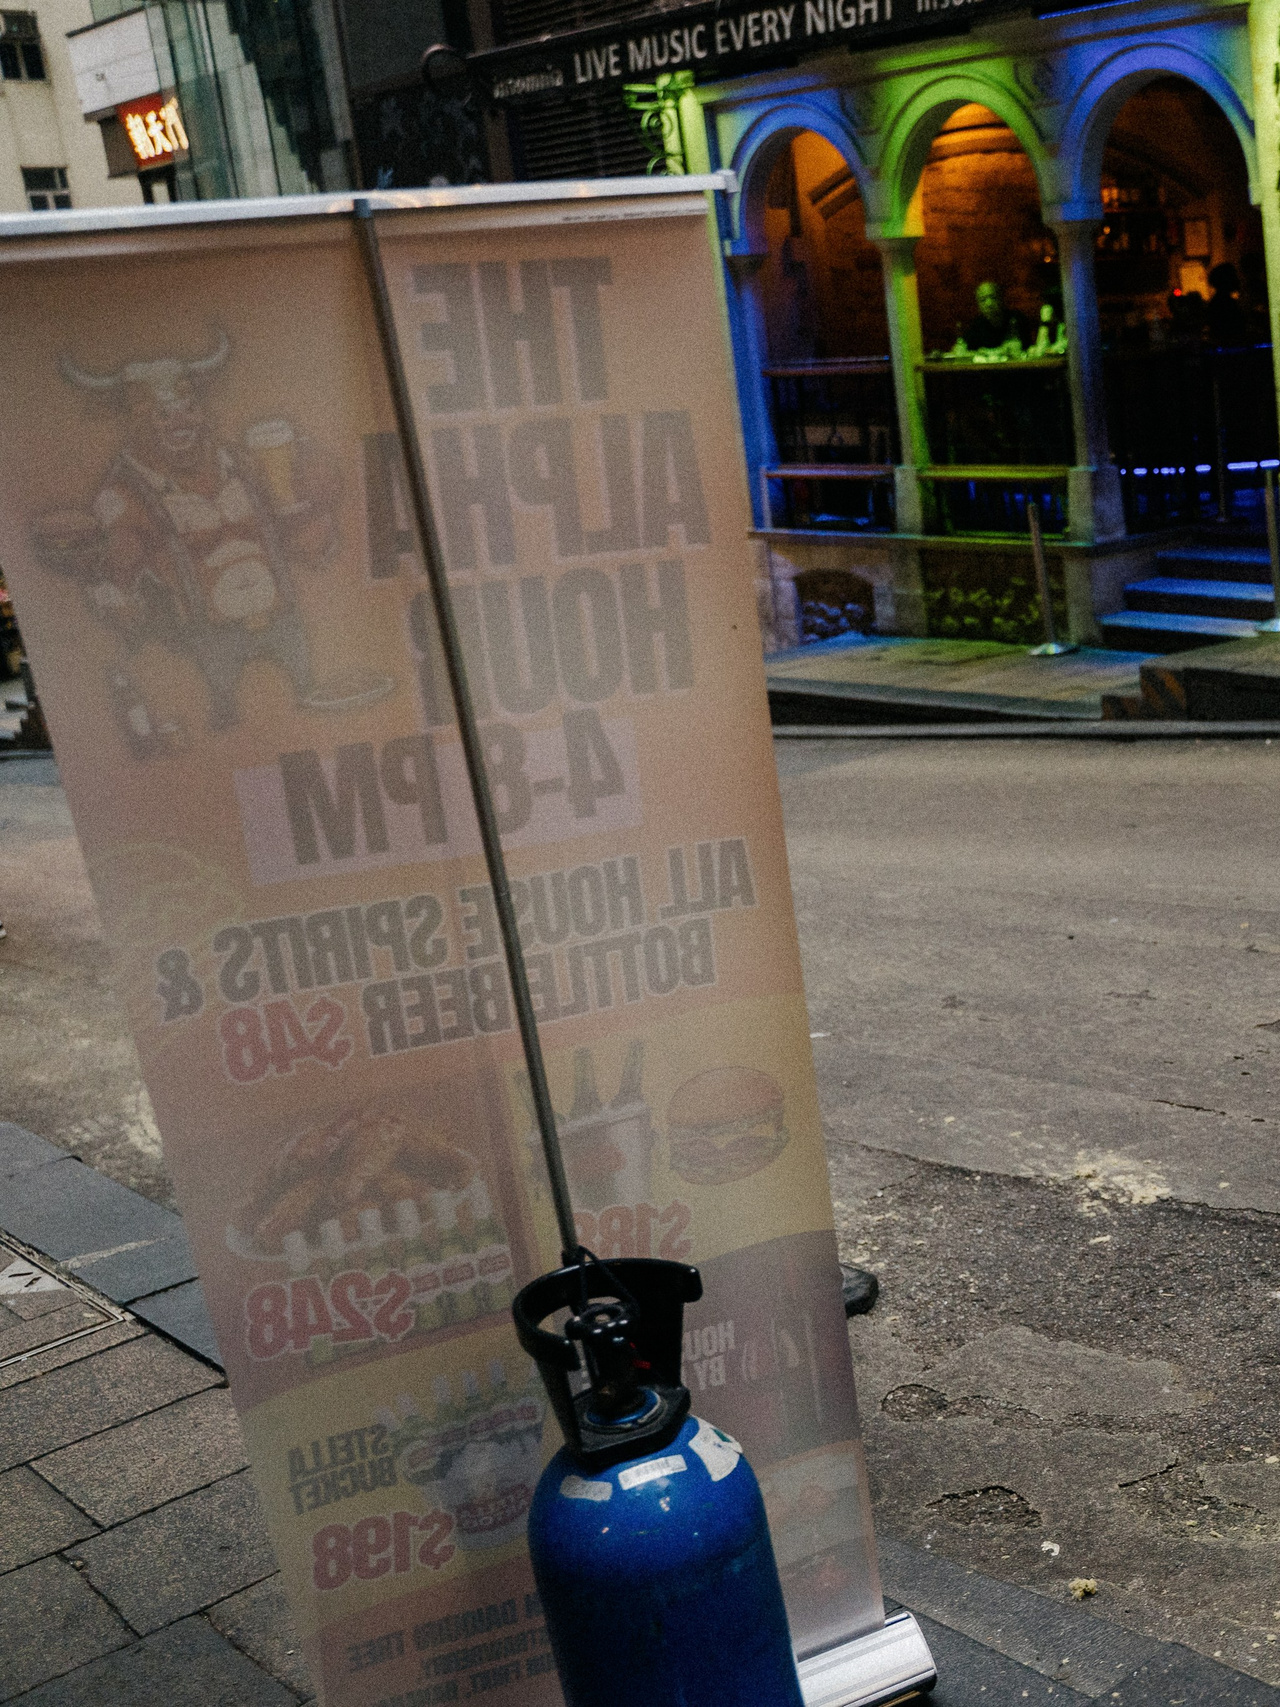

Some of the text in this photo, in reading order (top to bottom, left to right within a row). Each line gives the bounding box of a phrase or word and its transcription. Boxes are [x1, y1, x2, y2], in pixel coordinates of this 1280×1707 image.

[573, 43, 622, 85] LIVE
[626, 23, 708, 73] MUSIC
[713, 4, 795, 55] EVERY
